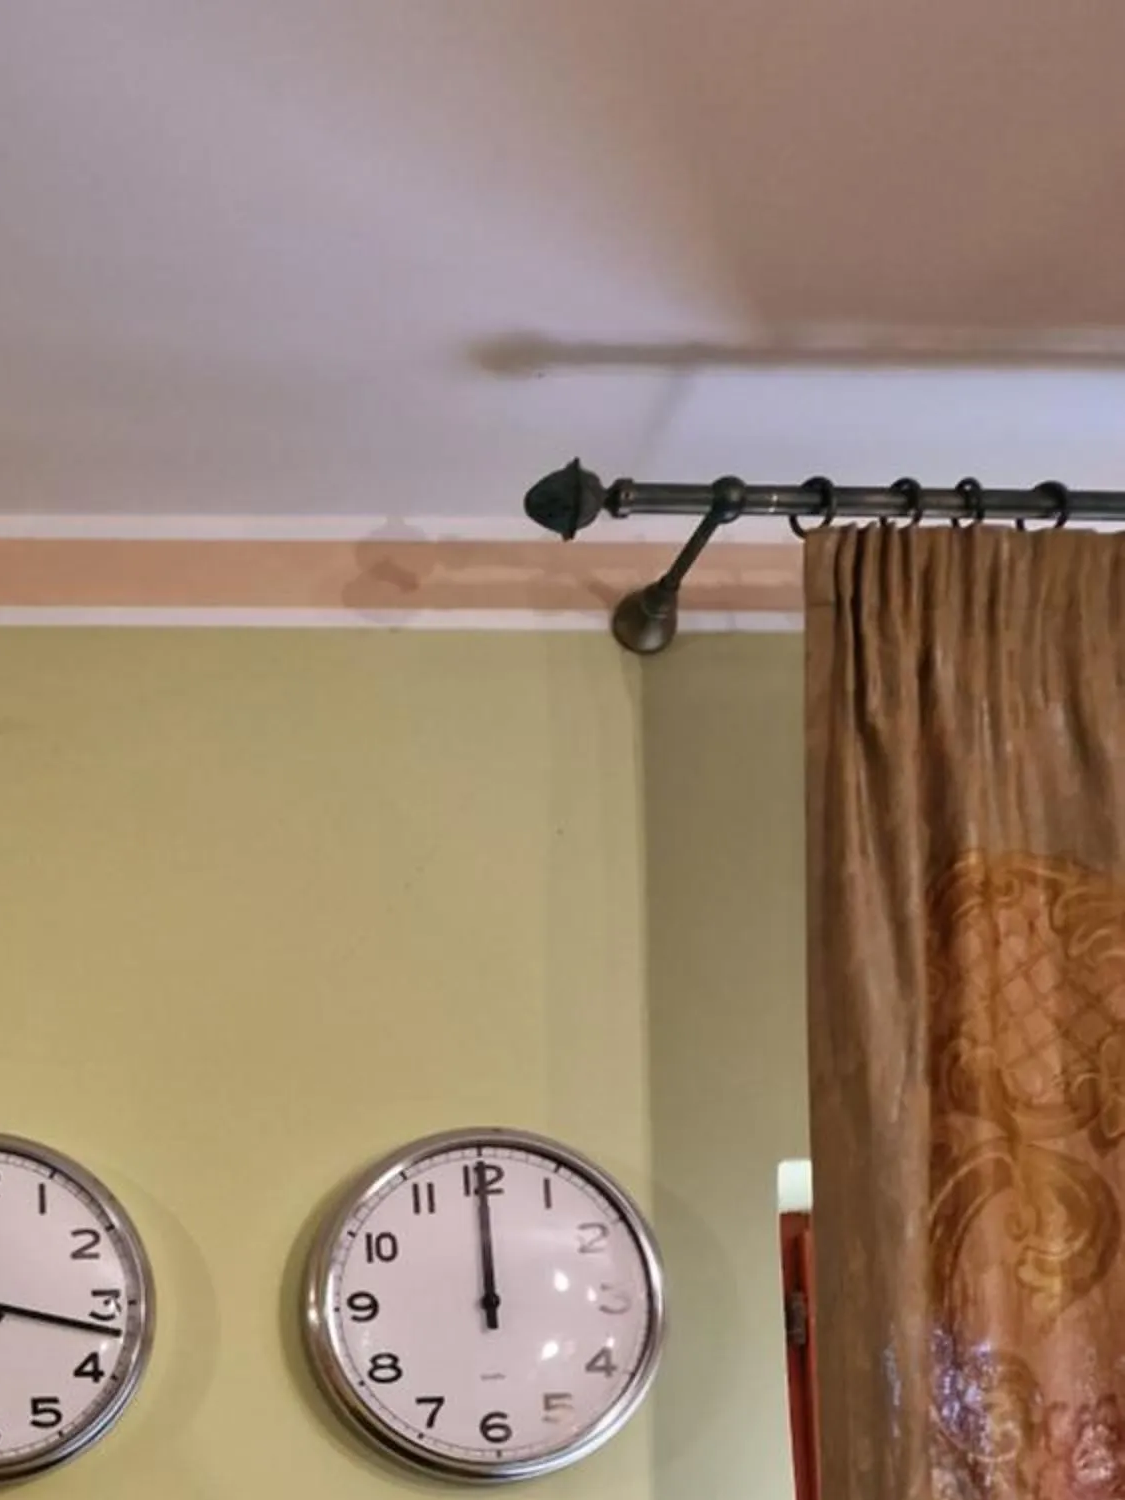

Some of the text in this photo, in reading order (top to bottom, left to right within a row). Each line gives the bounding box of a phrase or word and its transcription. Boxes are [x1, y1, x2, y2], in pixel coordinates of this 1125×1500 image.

[463, 1163, 505, 1197] 12
[70, 1229, 100, 1260] 2
[365, 1232, 398, 1264] 10
[576, 1222, 609, 1254] 2
[346, 1291, 379, 1323] 9
[73, 1352, 104, 1383] 4
[367, 1352, 403, 1383] 8
[584, 1347, 617, 1378] 4
[30, 1396, 62, 1428] 5
[415, 1396, 445, 1429] 7
[479, 1412, 512, 1444] 6
